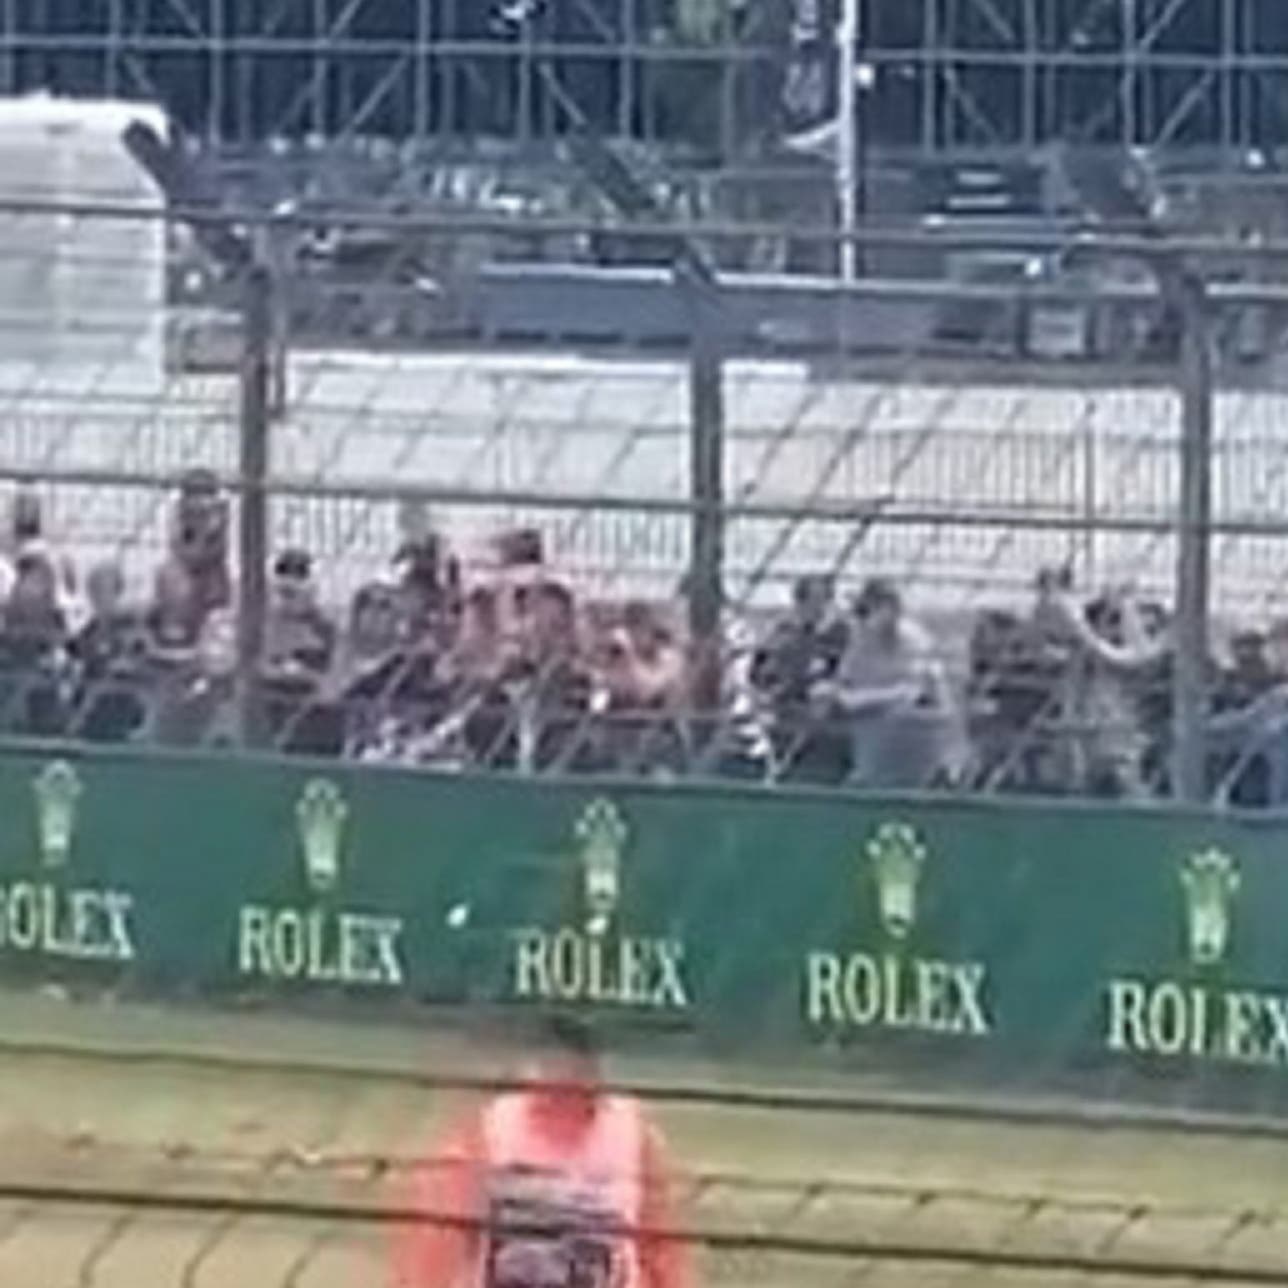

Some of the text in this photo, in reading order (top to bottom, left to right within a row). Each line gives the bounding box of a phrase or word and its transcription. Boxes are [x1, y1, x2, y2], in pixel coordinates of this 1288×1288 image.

[0, 881, 134, 959] OLEX
[239, 905, 402, 984] ROLEX
[516, 929, 687, 1006] ROLEX
[807, 951, 990, 1035] ROLEX
